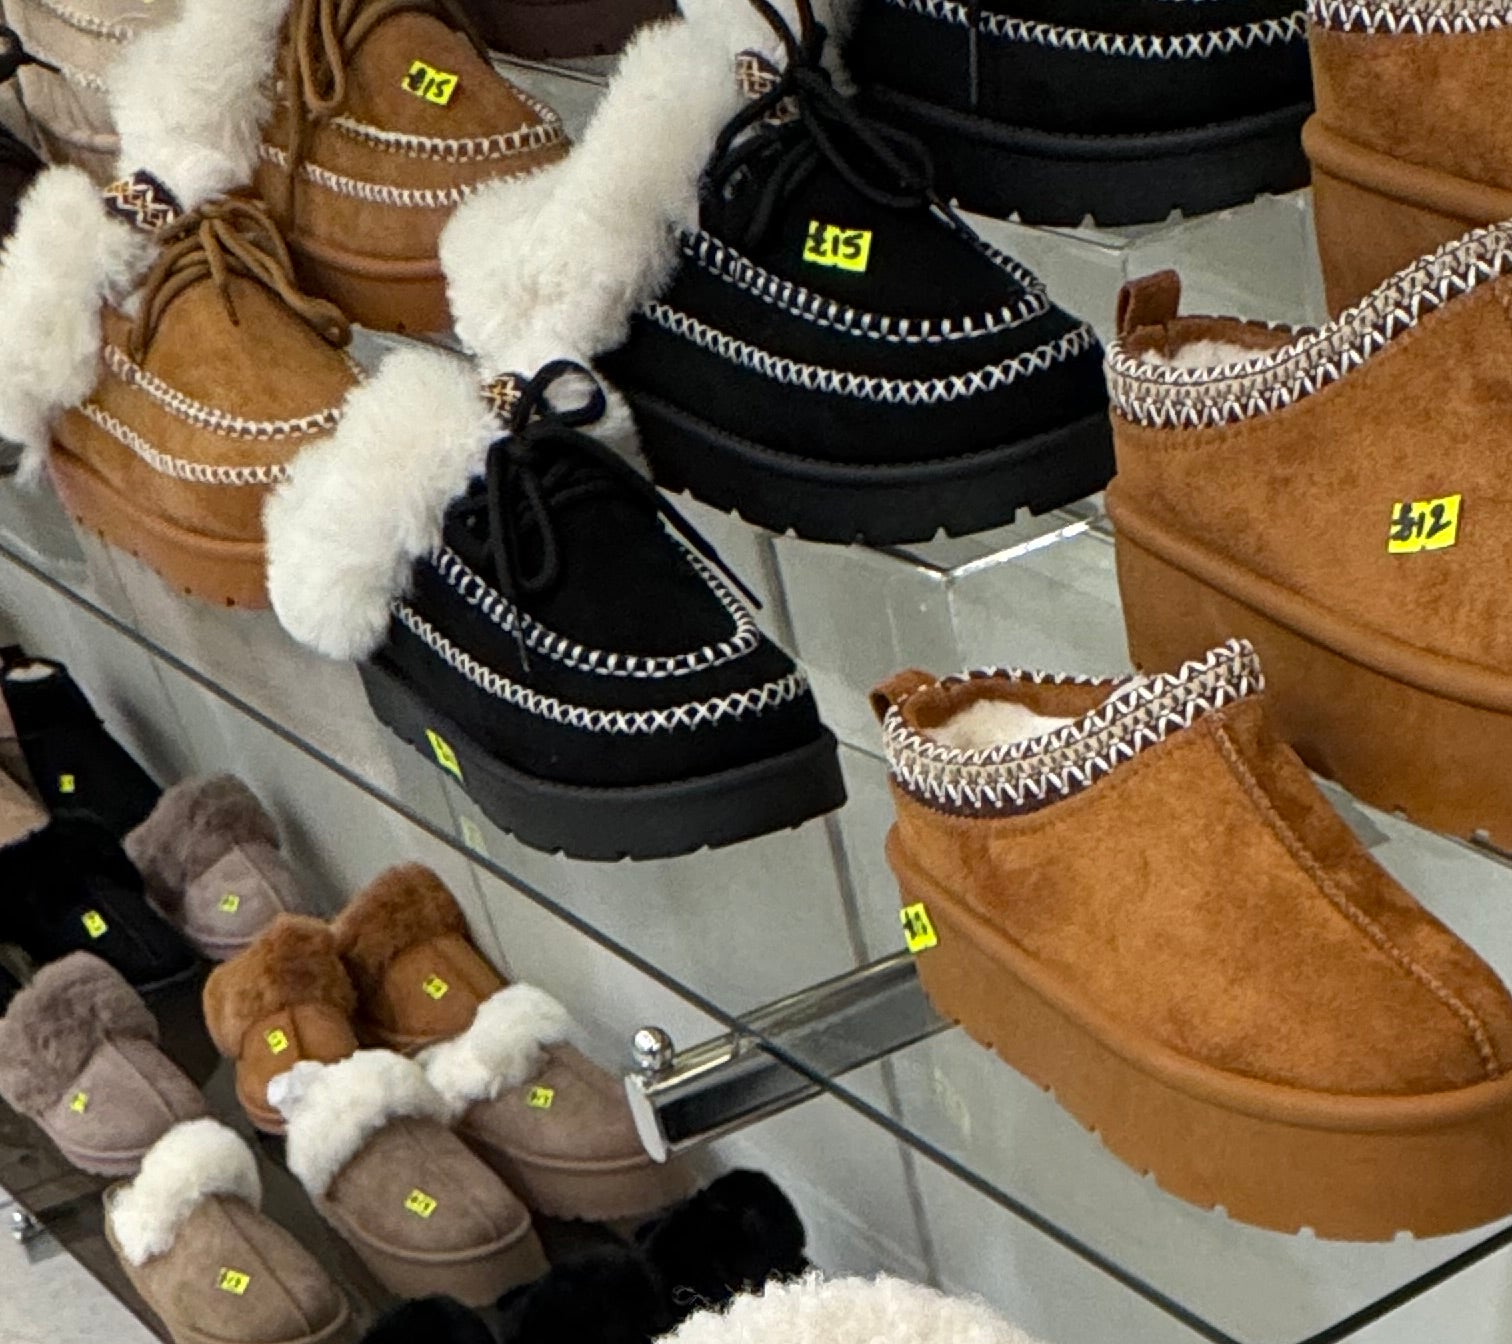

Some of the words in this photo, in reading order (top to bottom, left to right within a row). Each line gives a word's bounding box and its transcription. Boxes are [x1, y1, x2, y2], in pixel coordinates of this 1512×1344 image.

[408, 67, 452, 98] £15
[807, 225, 864, 260] £15
[1390, 502, 1452, 542] £12
